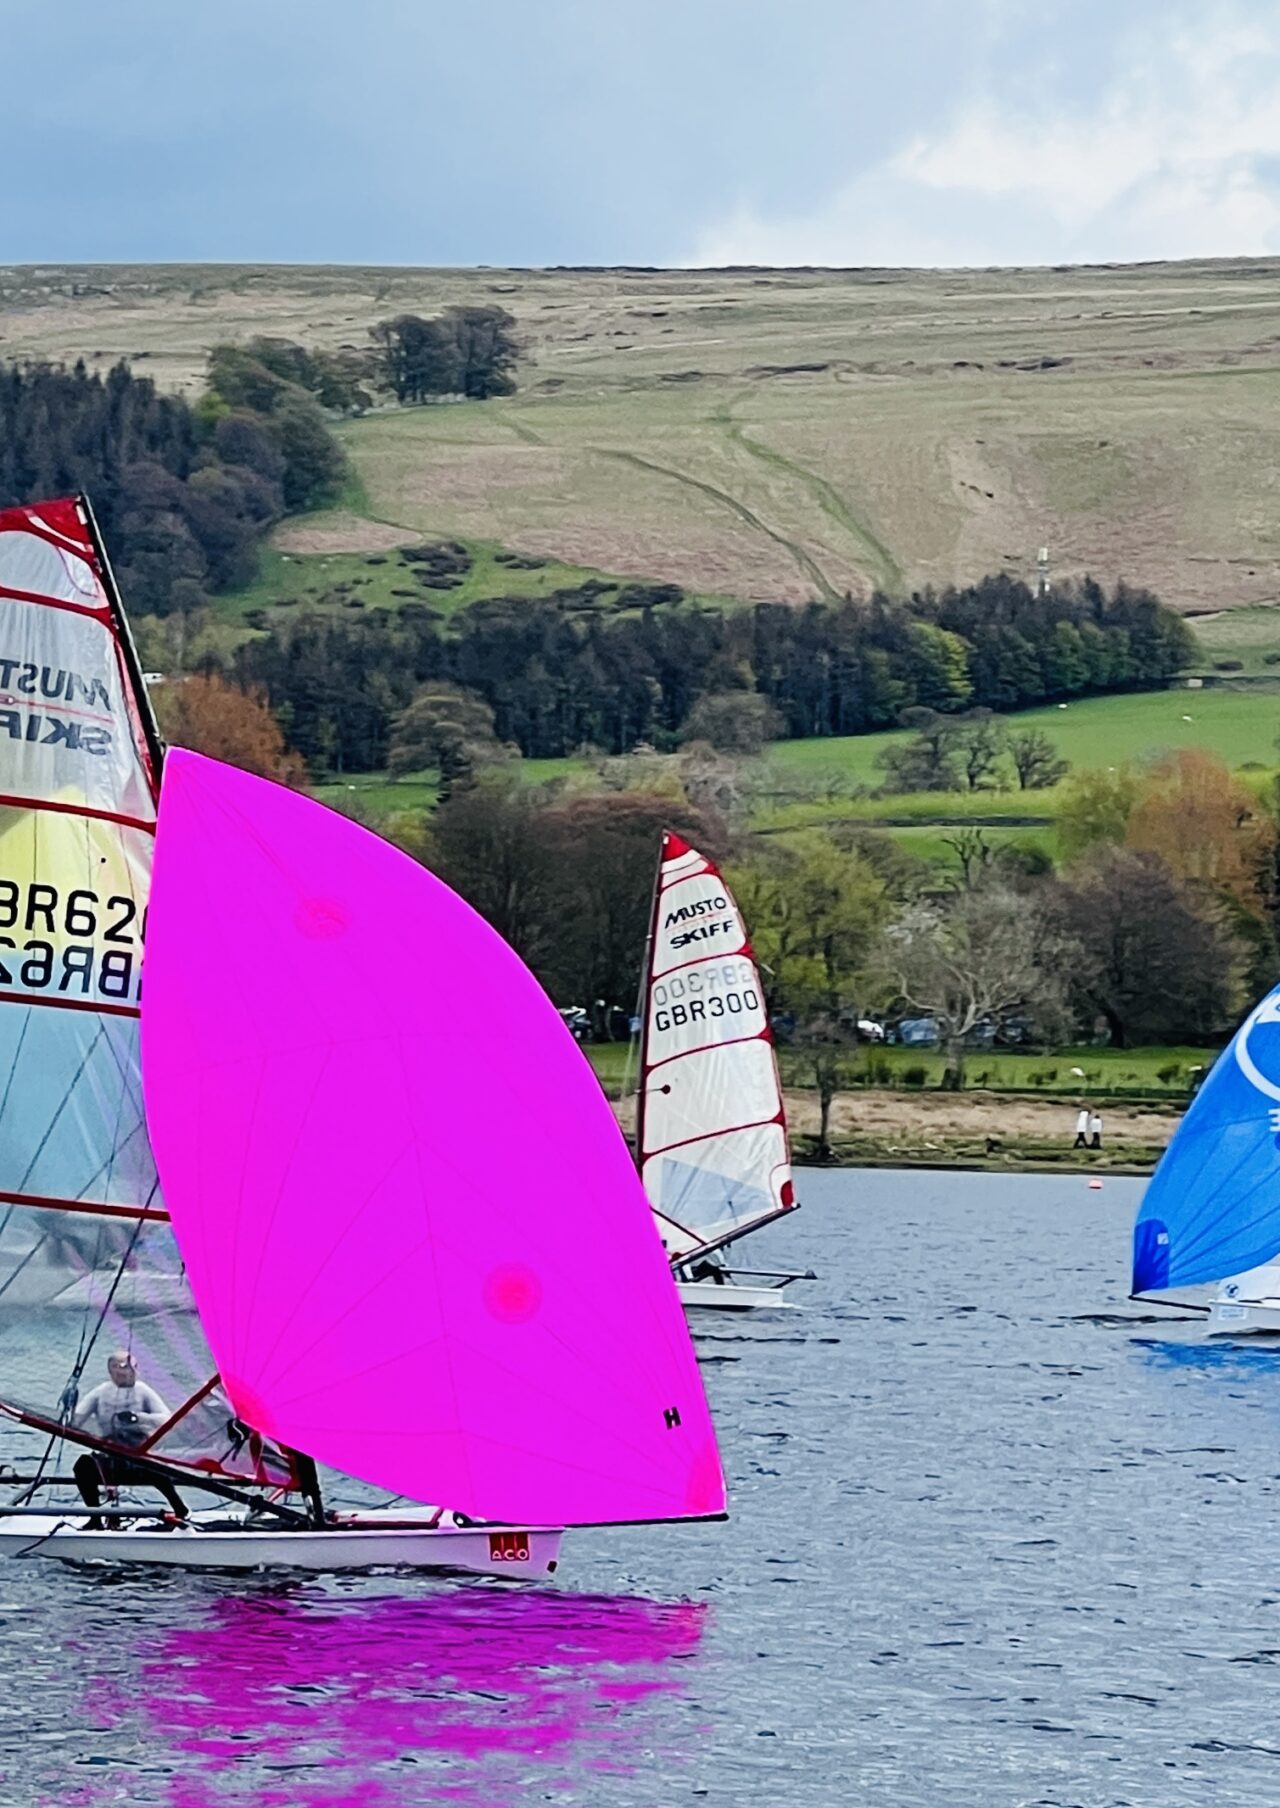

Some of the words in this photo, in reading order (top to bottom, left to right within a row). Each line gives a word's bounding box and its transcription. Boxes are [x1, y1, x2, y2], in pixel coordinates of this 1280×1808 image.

[664, 897, 727, 930] MUSTO
[669, 920, 734, 949] SKIFF
[655, 989, 759, 1032] GBR300
